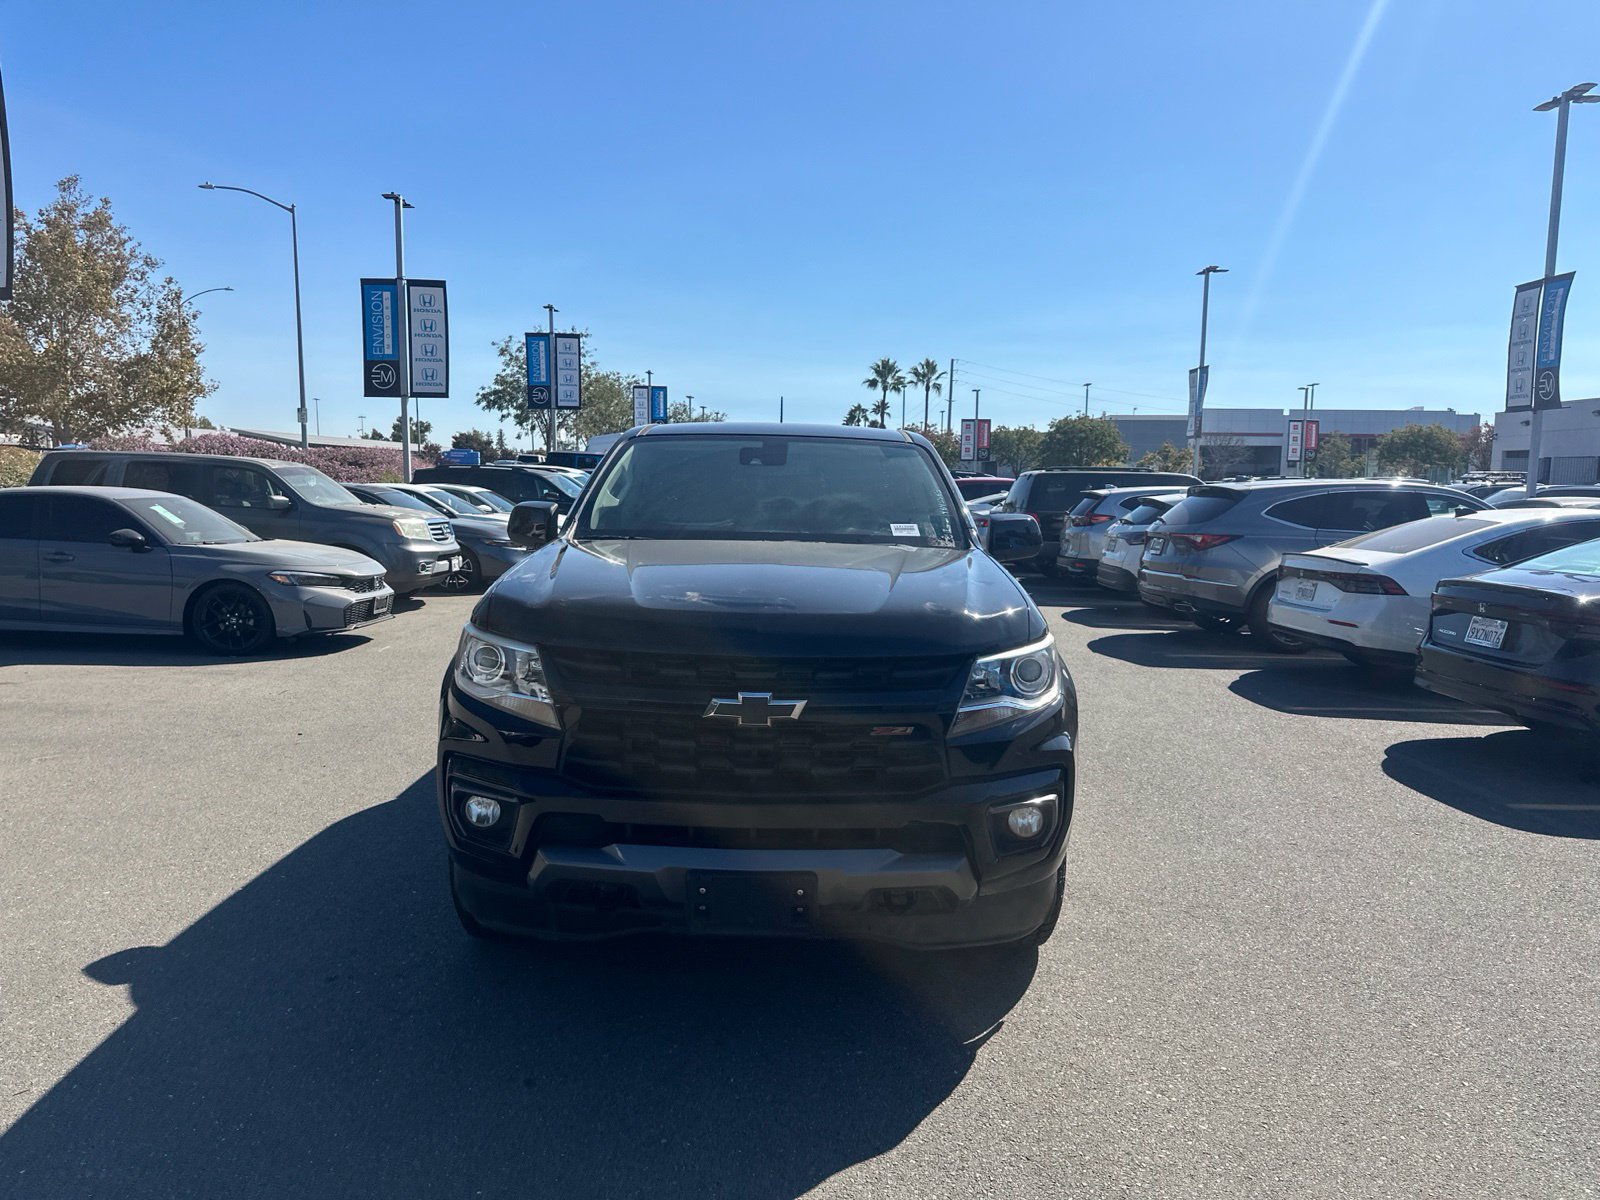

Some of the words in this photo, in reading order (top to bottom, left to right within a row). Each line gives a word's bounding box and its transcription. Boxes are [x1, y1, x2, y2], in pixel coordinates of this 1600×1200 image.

[371, 290, 384, 356] ENVISION
[1541, 288, 1558, 362] ENVISION
[532, 340, 541, 382] ENVISION
[1438, 628, 1457, 636] ACCORD
[1469, 626, 1503, 644] 9XZN076
